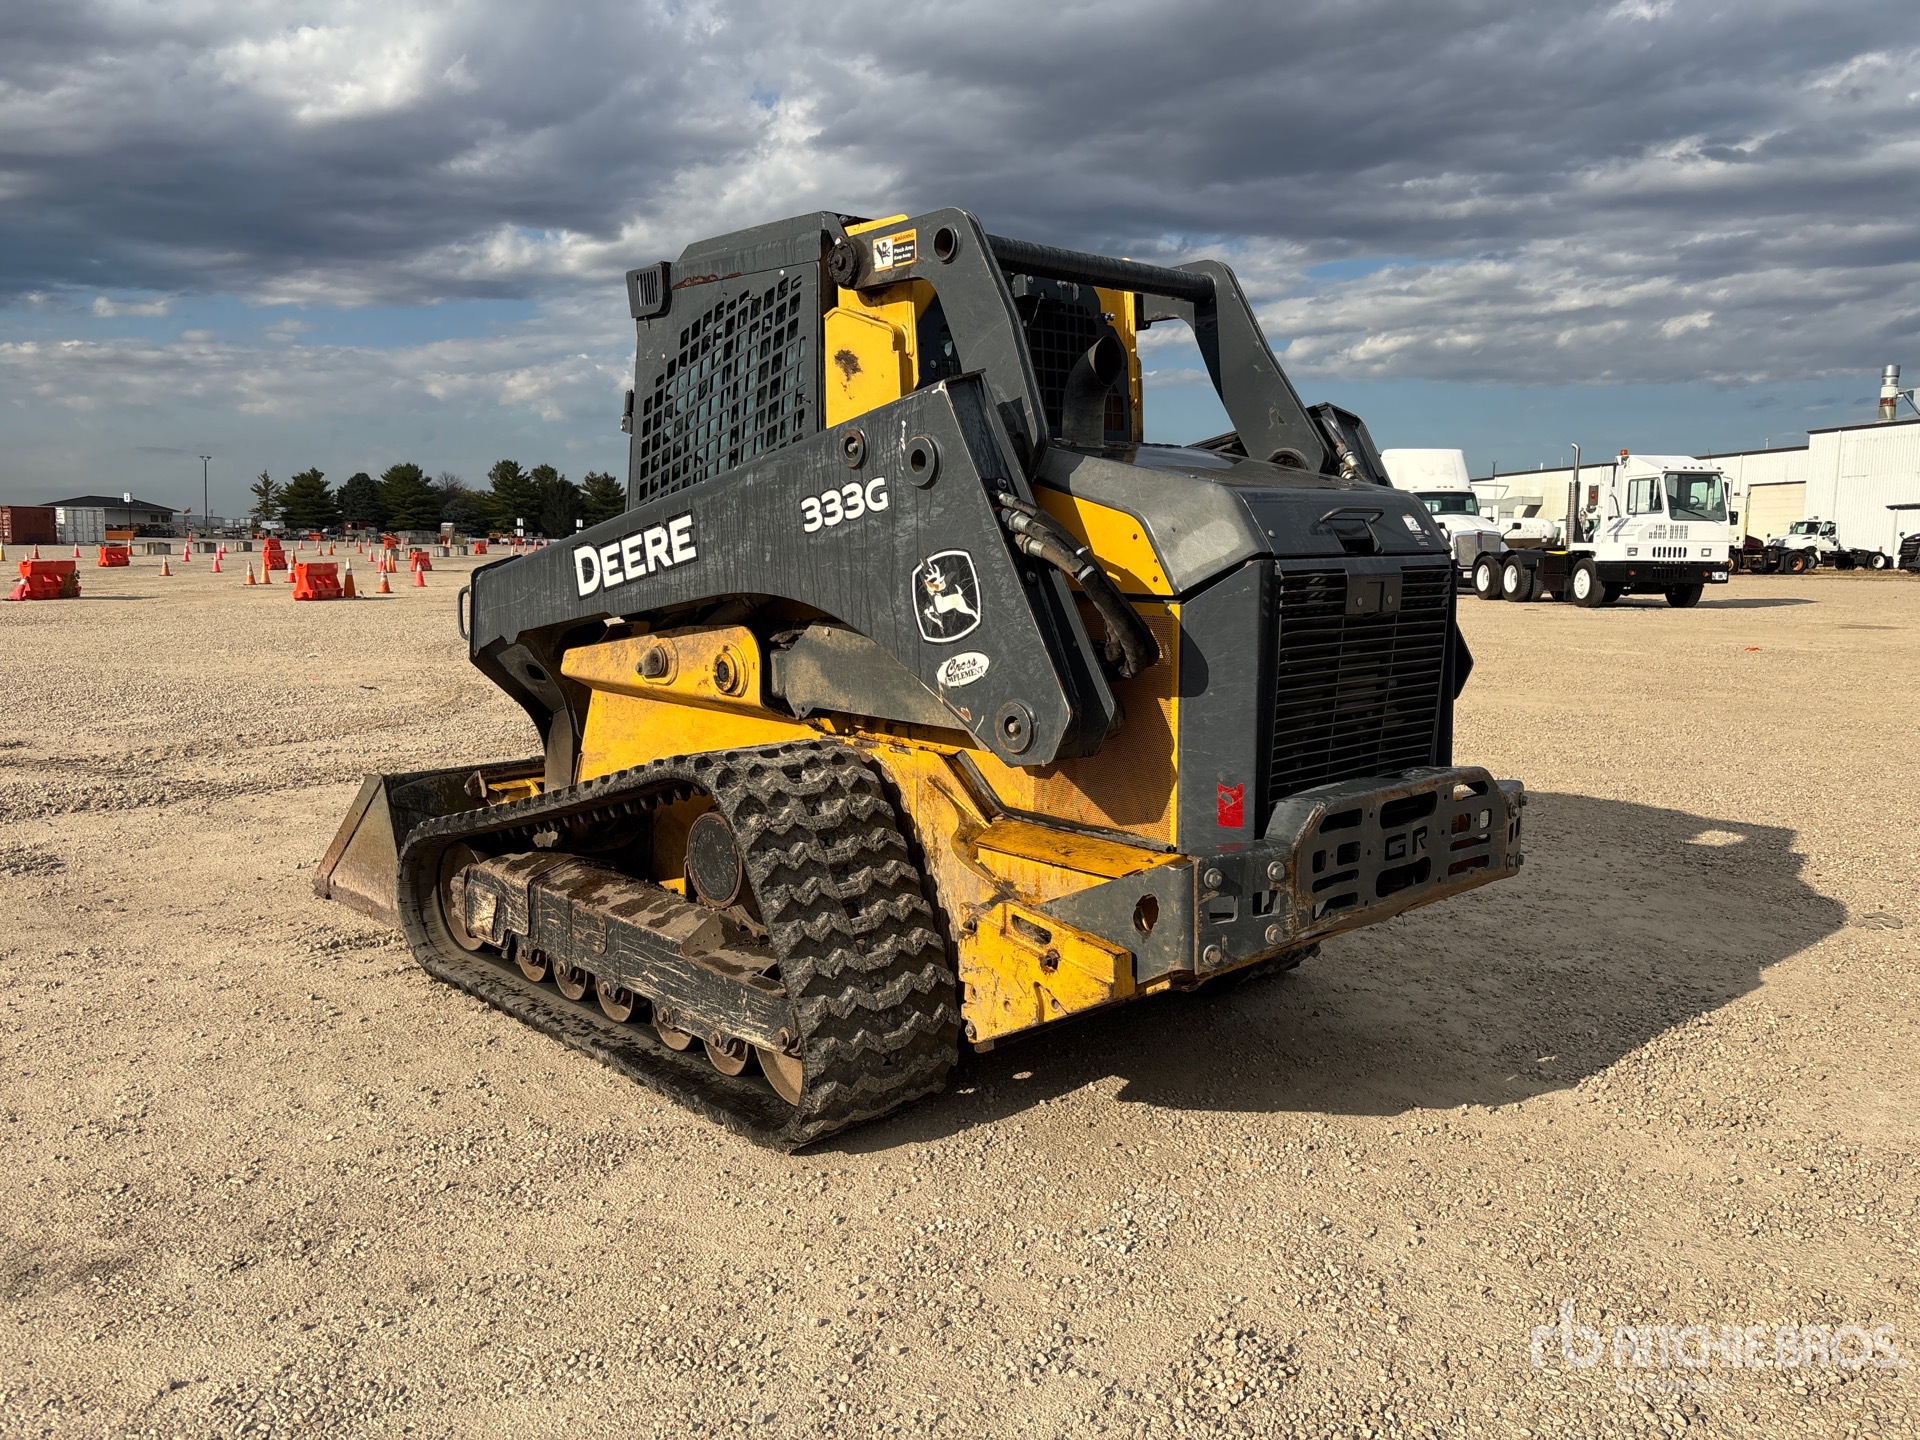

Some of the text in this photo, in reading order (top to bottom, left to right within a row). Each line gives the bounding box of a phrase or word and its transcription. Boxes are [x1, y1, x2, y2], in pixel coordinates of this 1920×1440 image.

[801, 477, 889, 533] 333G
[573, 515, 697, 597] DEERE
[945, 666, 984, 685] IMPLEMENT
[946, 658, 977, 677] Cross
[1385, 826, 1427, 861] GR
